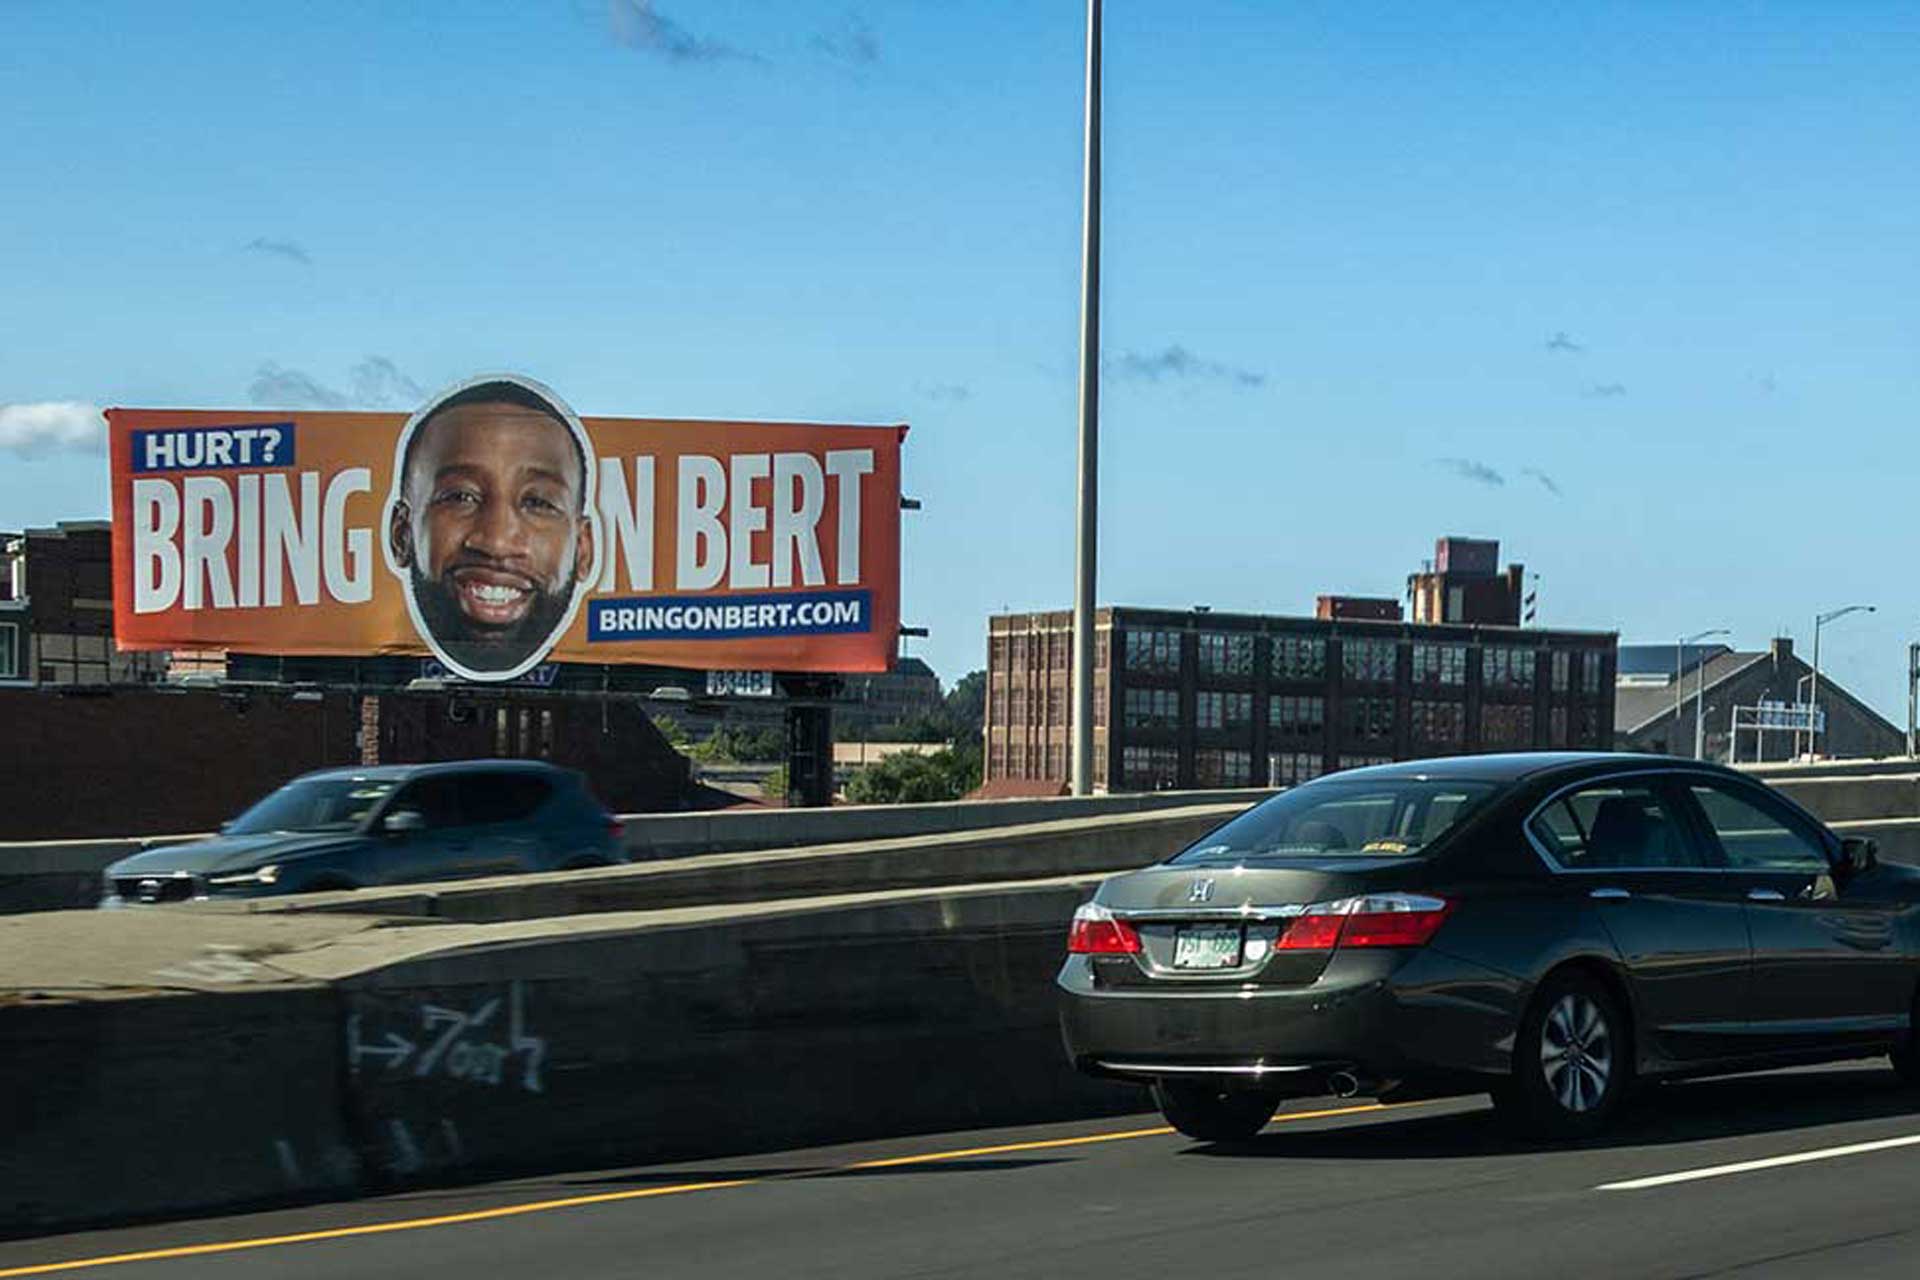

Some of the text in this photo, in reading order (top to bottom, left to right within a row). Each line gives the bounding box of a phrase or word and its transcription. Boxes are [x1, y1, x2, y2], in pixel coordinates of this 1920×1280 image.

[145, 428, 282, 468] HURT?
[132, 467, 373, 614] BRING
[676, 448, 874, 590] BERT
[599, 601, 860, 632] BRINGONBERT.COM
